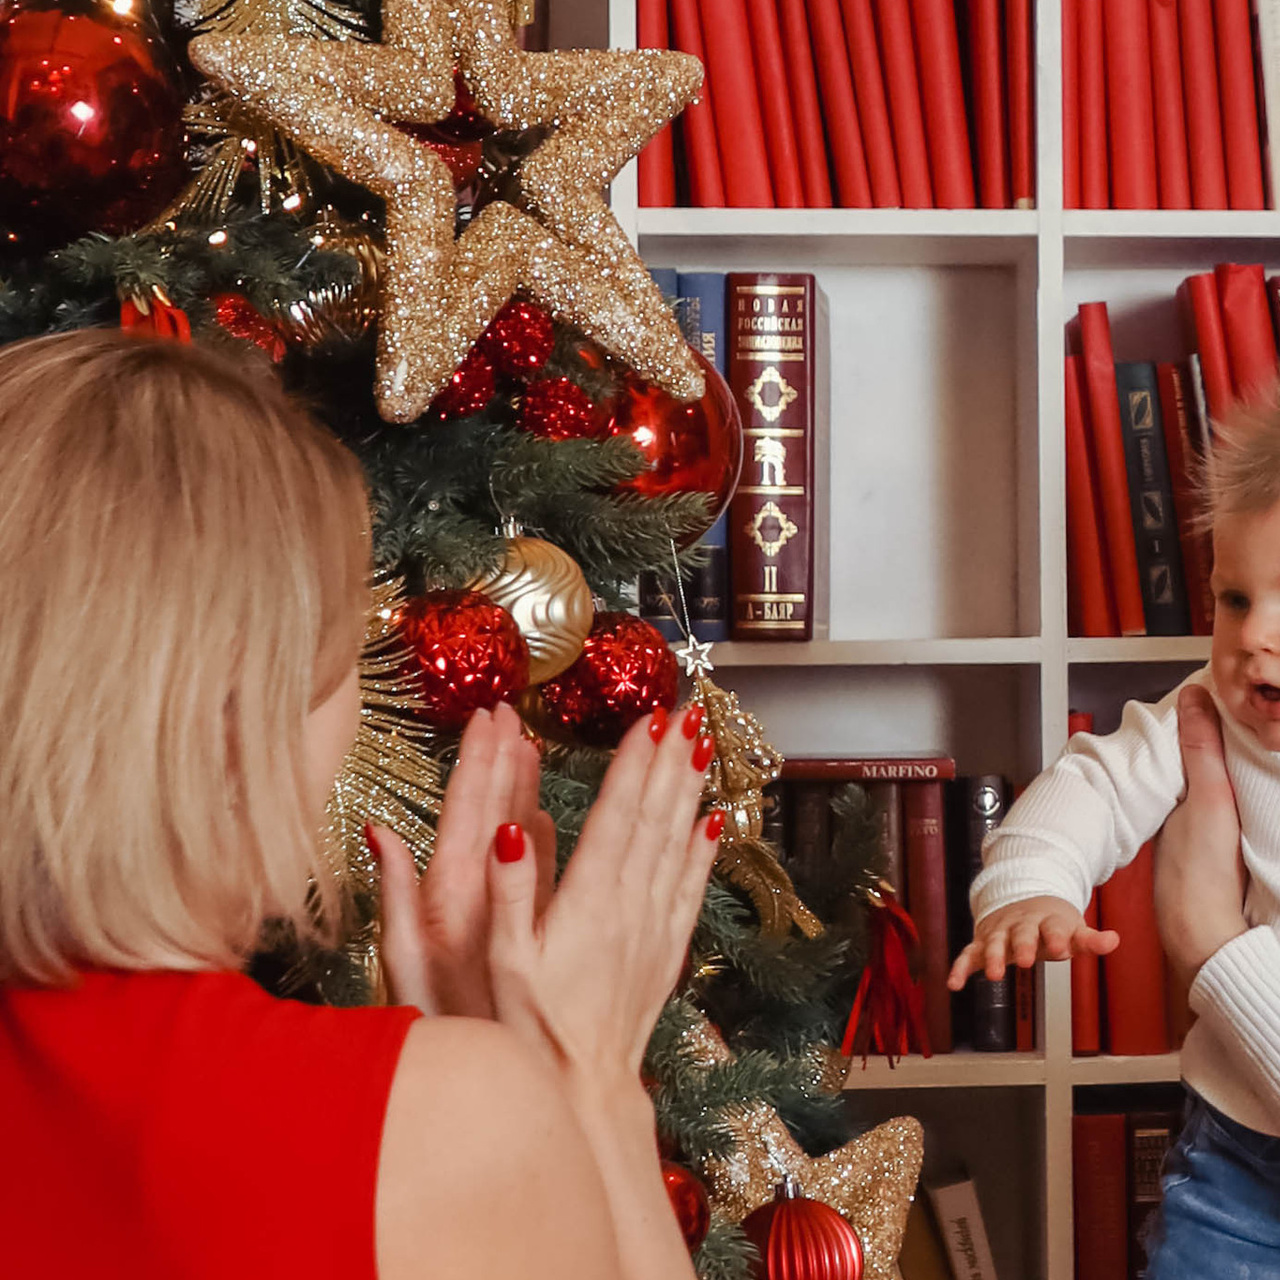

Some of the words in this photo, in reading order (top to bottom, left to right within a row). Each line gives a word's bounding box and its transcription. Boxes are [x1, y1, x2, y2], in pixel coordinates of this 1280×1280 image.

[738, 299, 803, 313] НОВАЯ
[738, 316, 803, 330] РОССИЙСКАЯ
[738, 336, 803, 349] ЭНЦИКЛОПЕДИЯ
[764, 566, 777, 591] II
[862, 763, 937, 779] MARFINO
